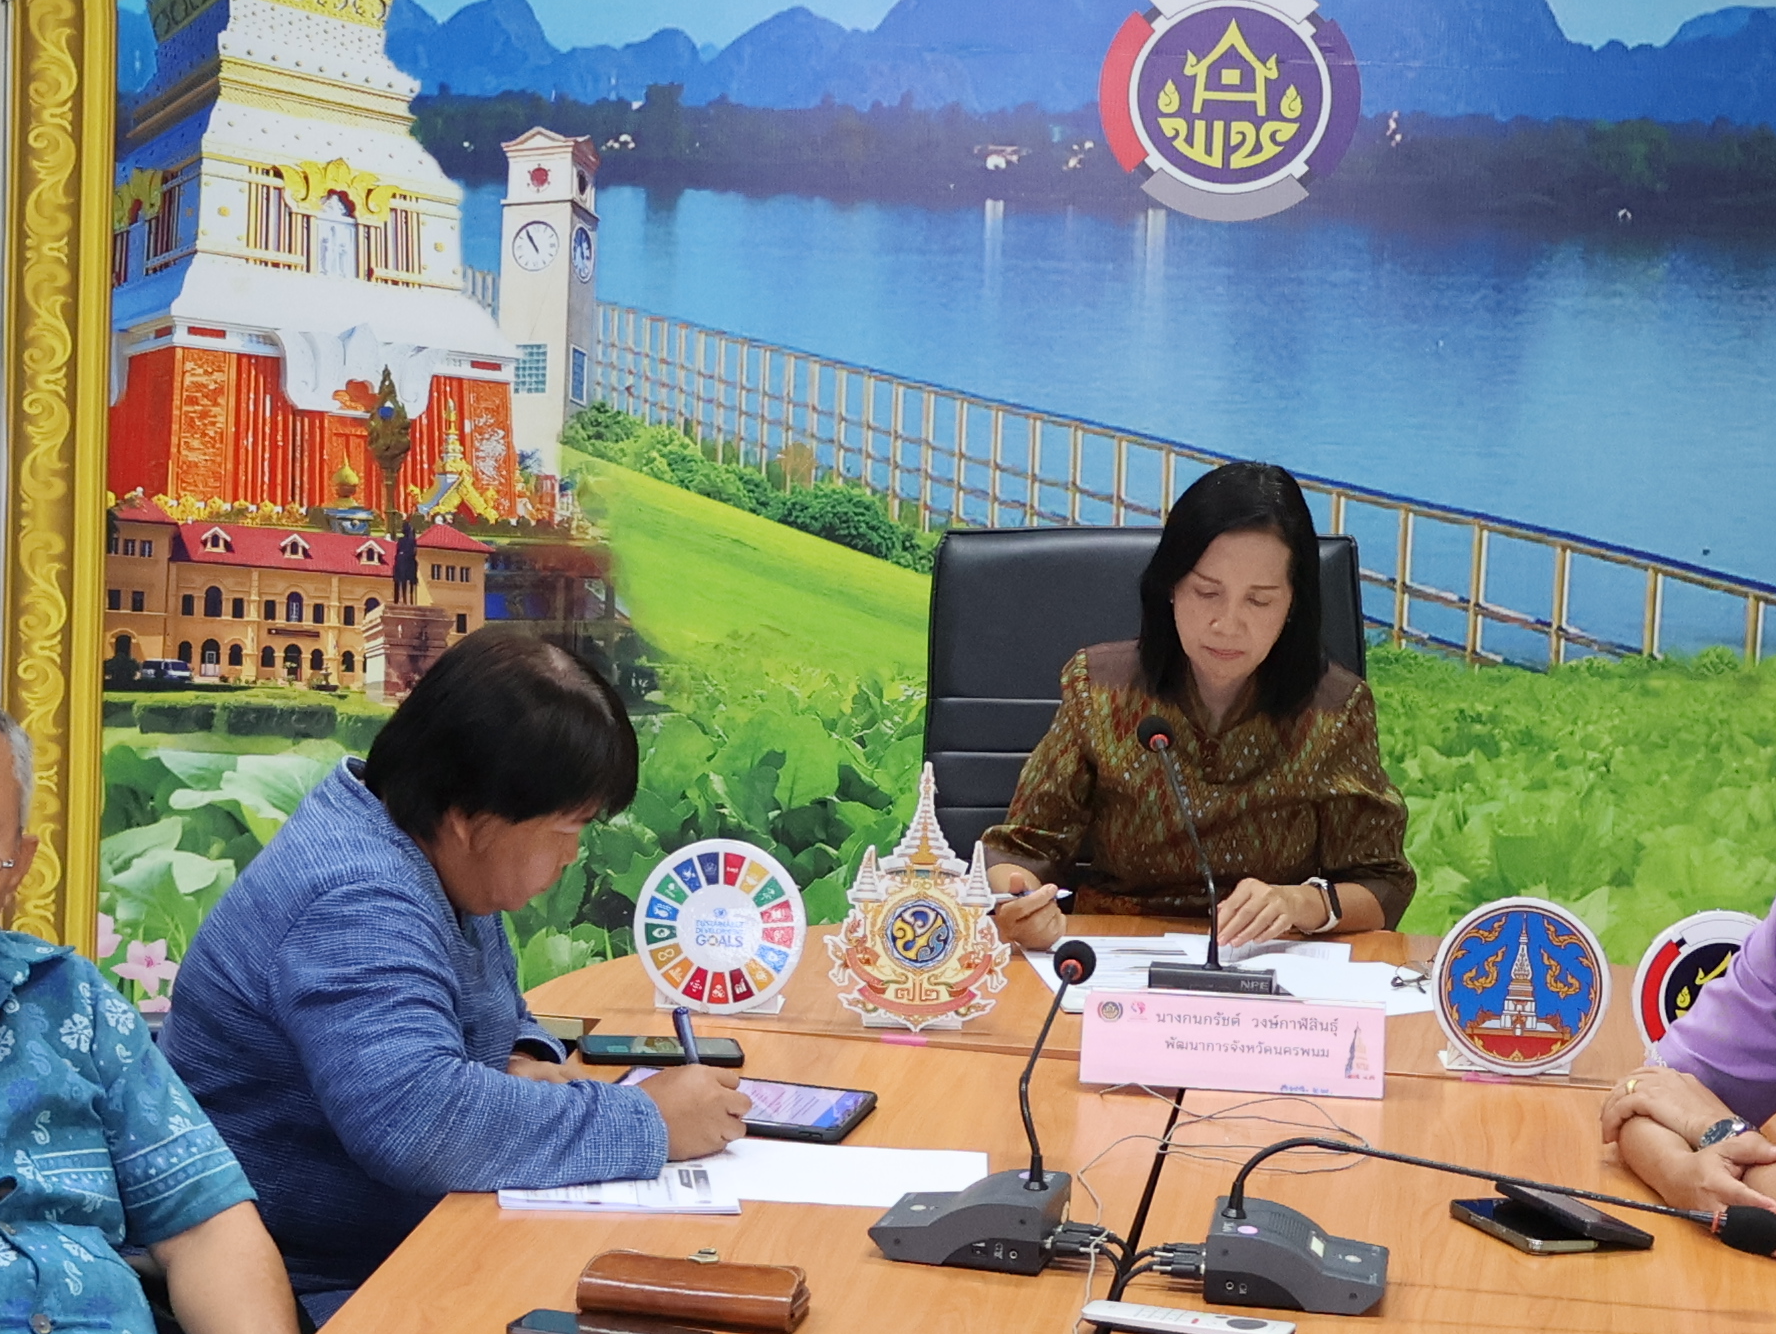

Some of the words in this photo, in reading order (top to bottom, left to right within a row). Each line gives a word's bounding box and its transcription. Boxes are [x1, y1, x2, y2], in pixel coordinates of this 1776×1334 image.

[695, 935, 744, 948] GOALS
[1240, 980, 1269, 991] NPE
[1165, 1037, 1330, 1058] พัฒนาการจังหวัดนครพนม
